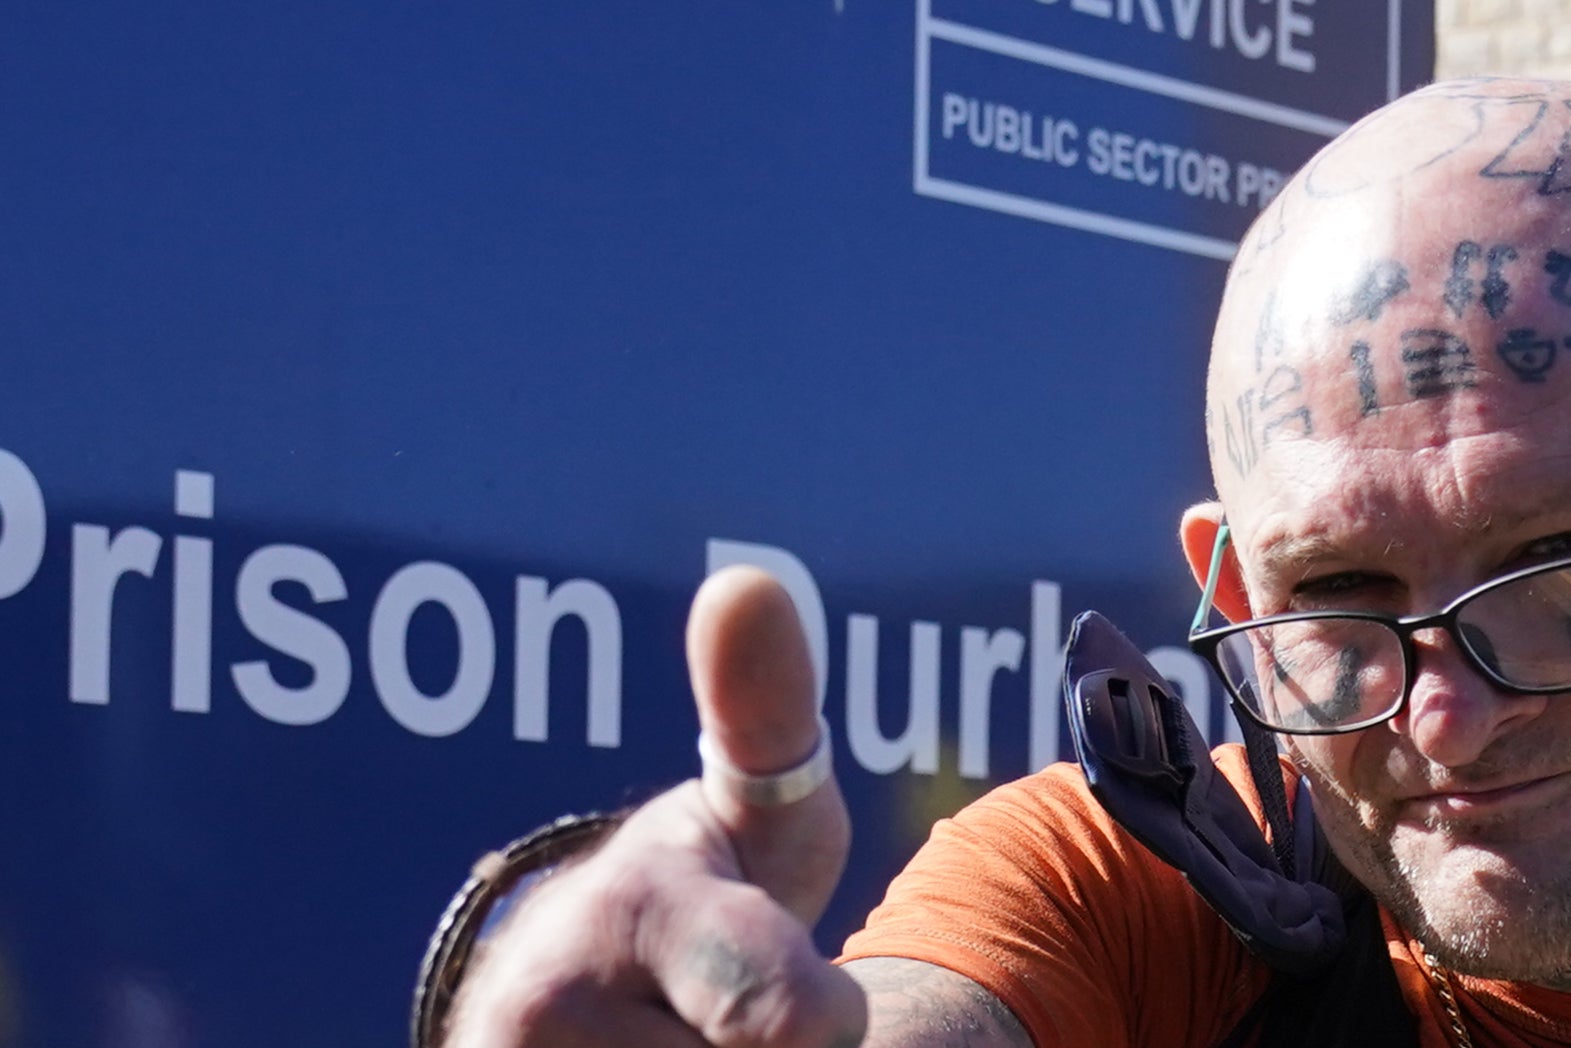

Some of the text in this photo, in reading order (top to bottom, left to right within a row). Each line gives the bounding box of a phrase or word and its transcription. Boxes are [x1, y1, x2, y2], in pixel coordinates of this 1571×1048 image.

[1035, 0, 1316, 72] VICE
[942, 93, 1291, 209] PUBLIC SECTOR PR
[705, 537, 1270, 779] Durh
